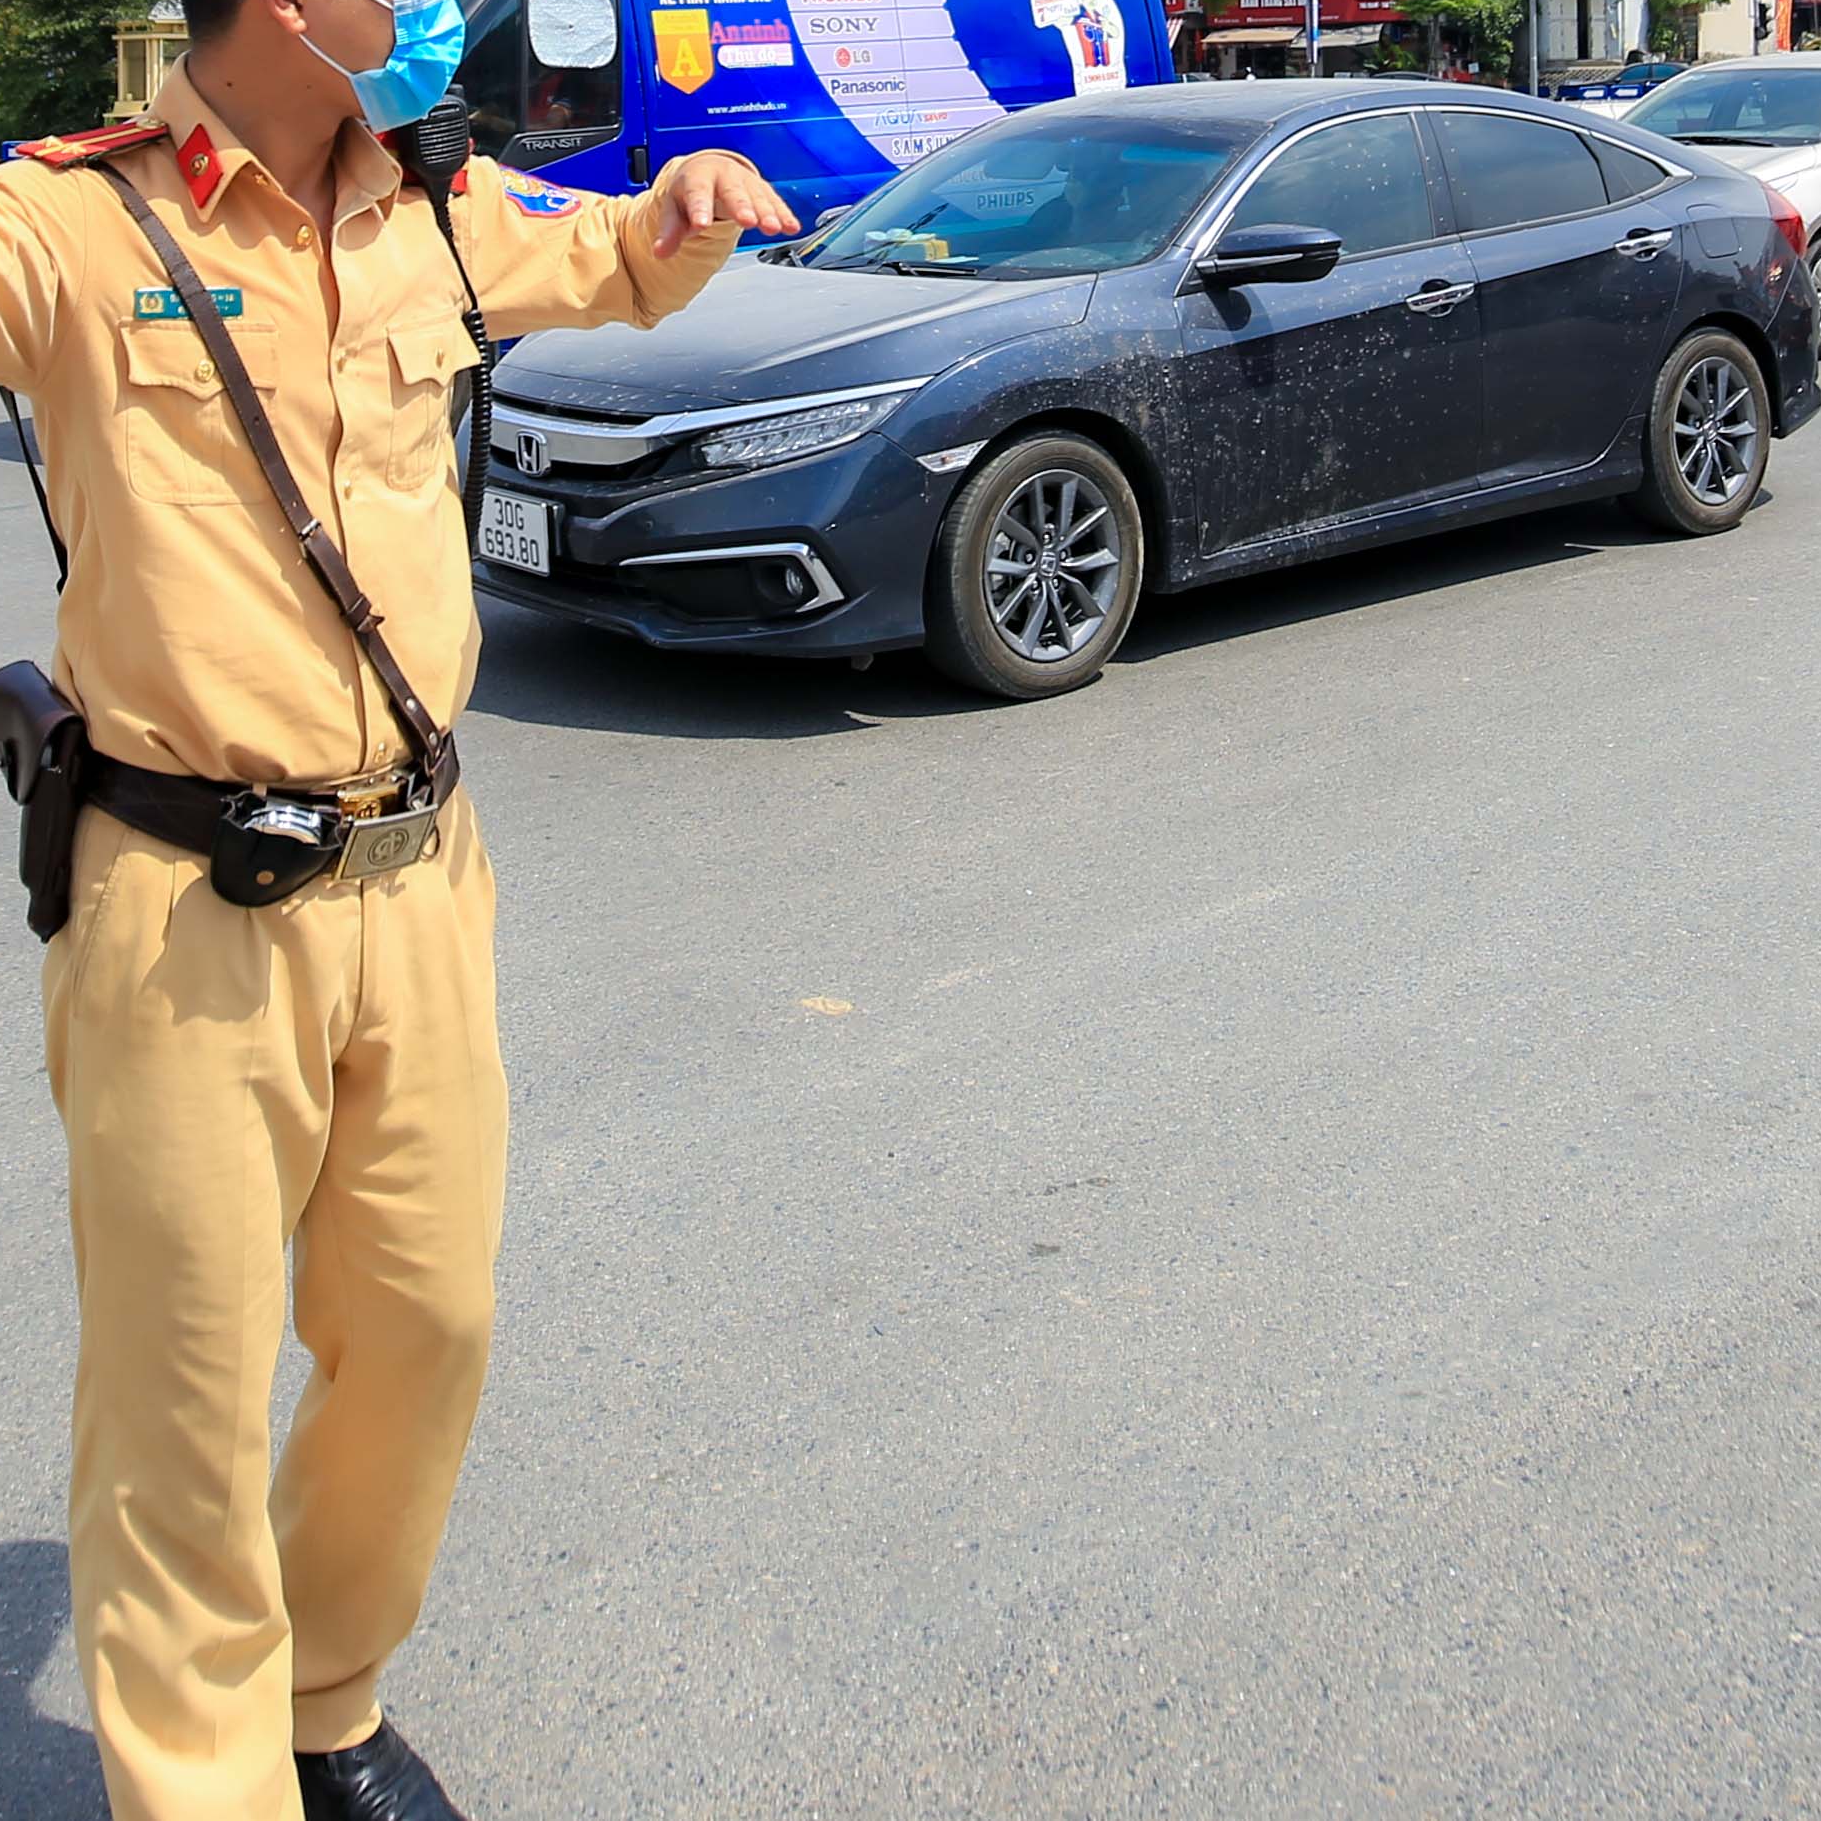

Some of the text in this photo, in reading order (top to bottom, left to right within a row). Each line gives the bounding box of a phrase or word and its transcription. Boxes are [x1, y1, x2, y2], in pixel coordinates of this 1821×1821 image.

[810, 17, 878, 35] SONY
[671, 38, 704, 77] A
[853, 50, 871, 63] LG
[831, 77, 905, 96] Panasonic
[523, 137, 582, 151] TRANSIT
[977, 190, 1035, 209] PHILIPS
[494, 498, 525, 531] 30G
[485, 527, 540, 567] 693.80
